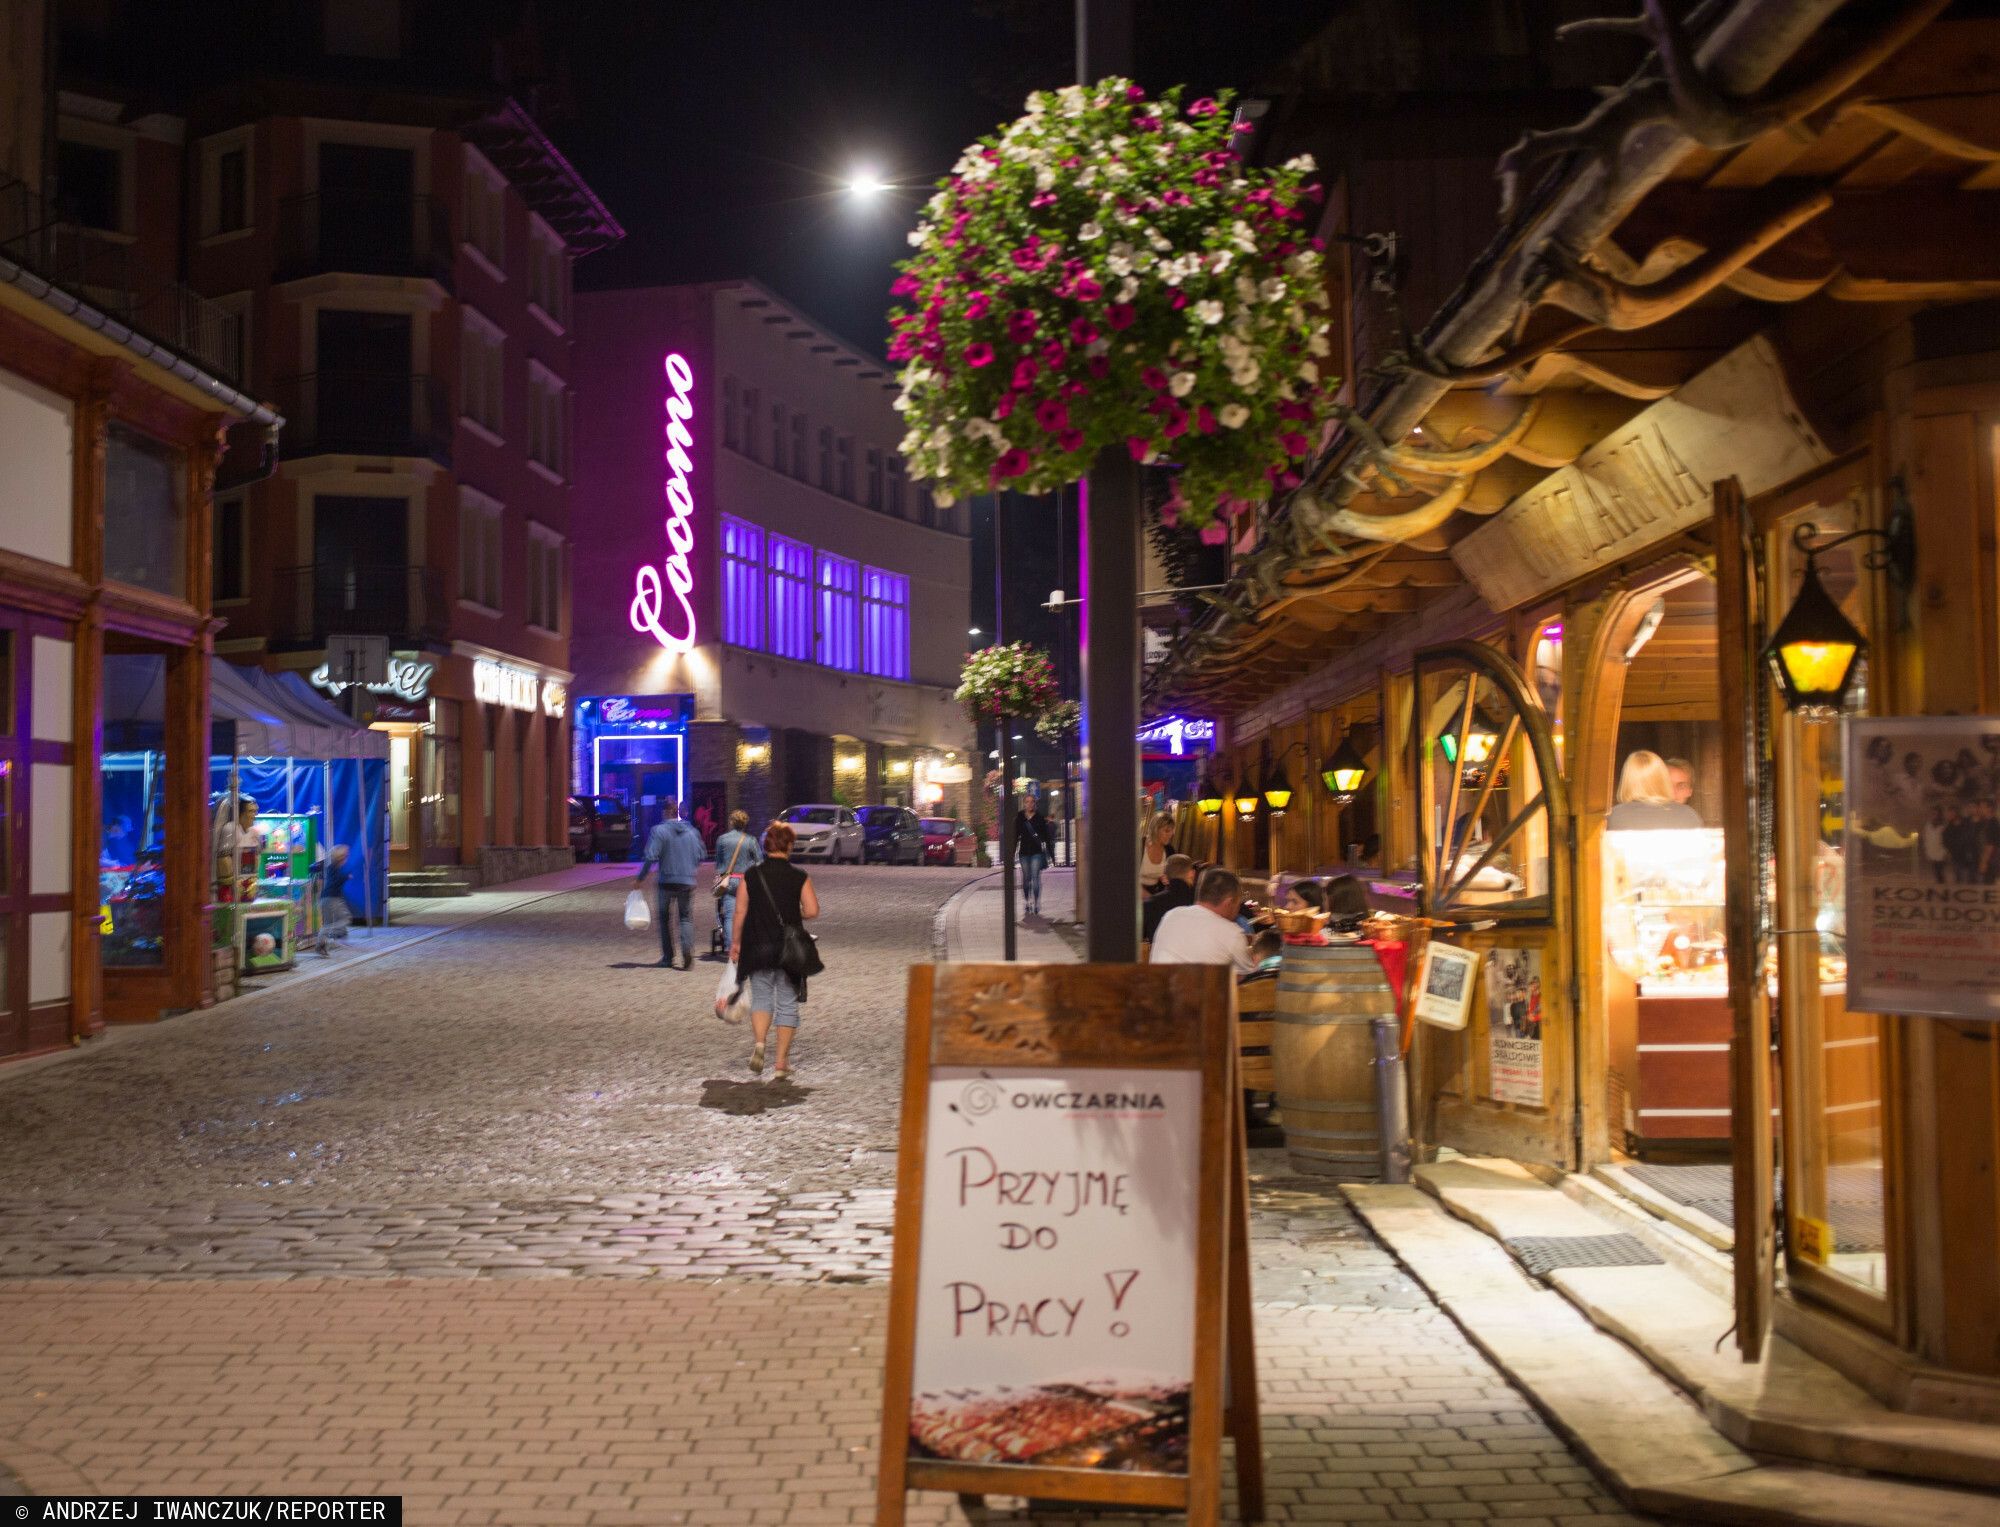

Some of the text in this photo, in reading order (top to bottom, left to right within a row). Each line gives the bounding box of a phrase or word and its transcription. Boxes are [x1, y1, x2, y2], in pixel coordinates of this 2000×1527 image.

[630, 353, 697, 655] Cocomo
[1011, 1092, 1165, 1110] OWCZARNIA
[999, 1222, 1058, 1250] DO
